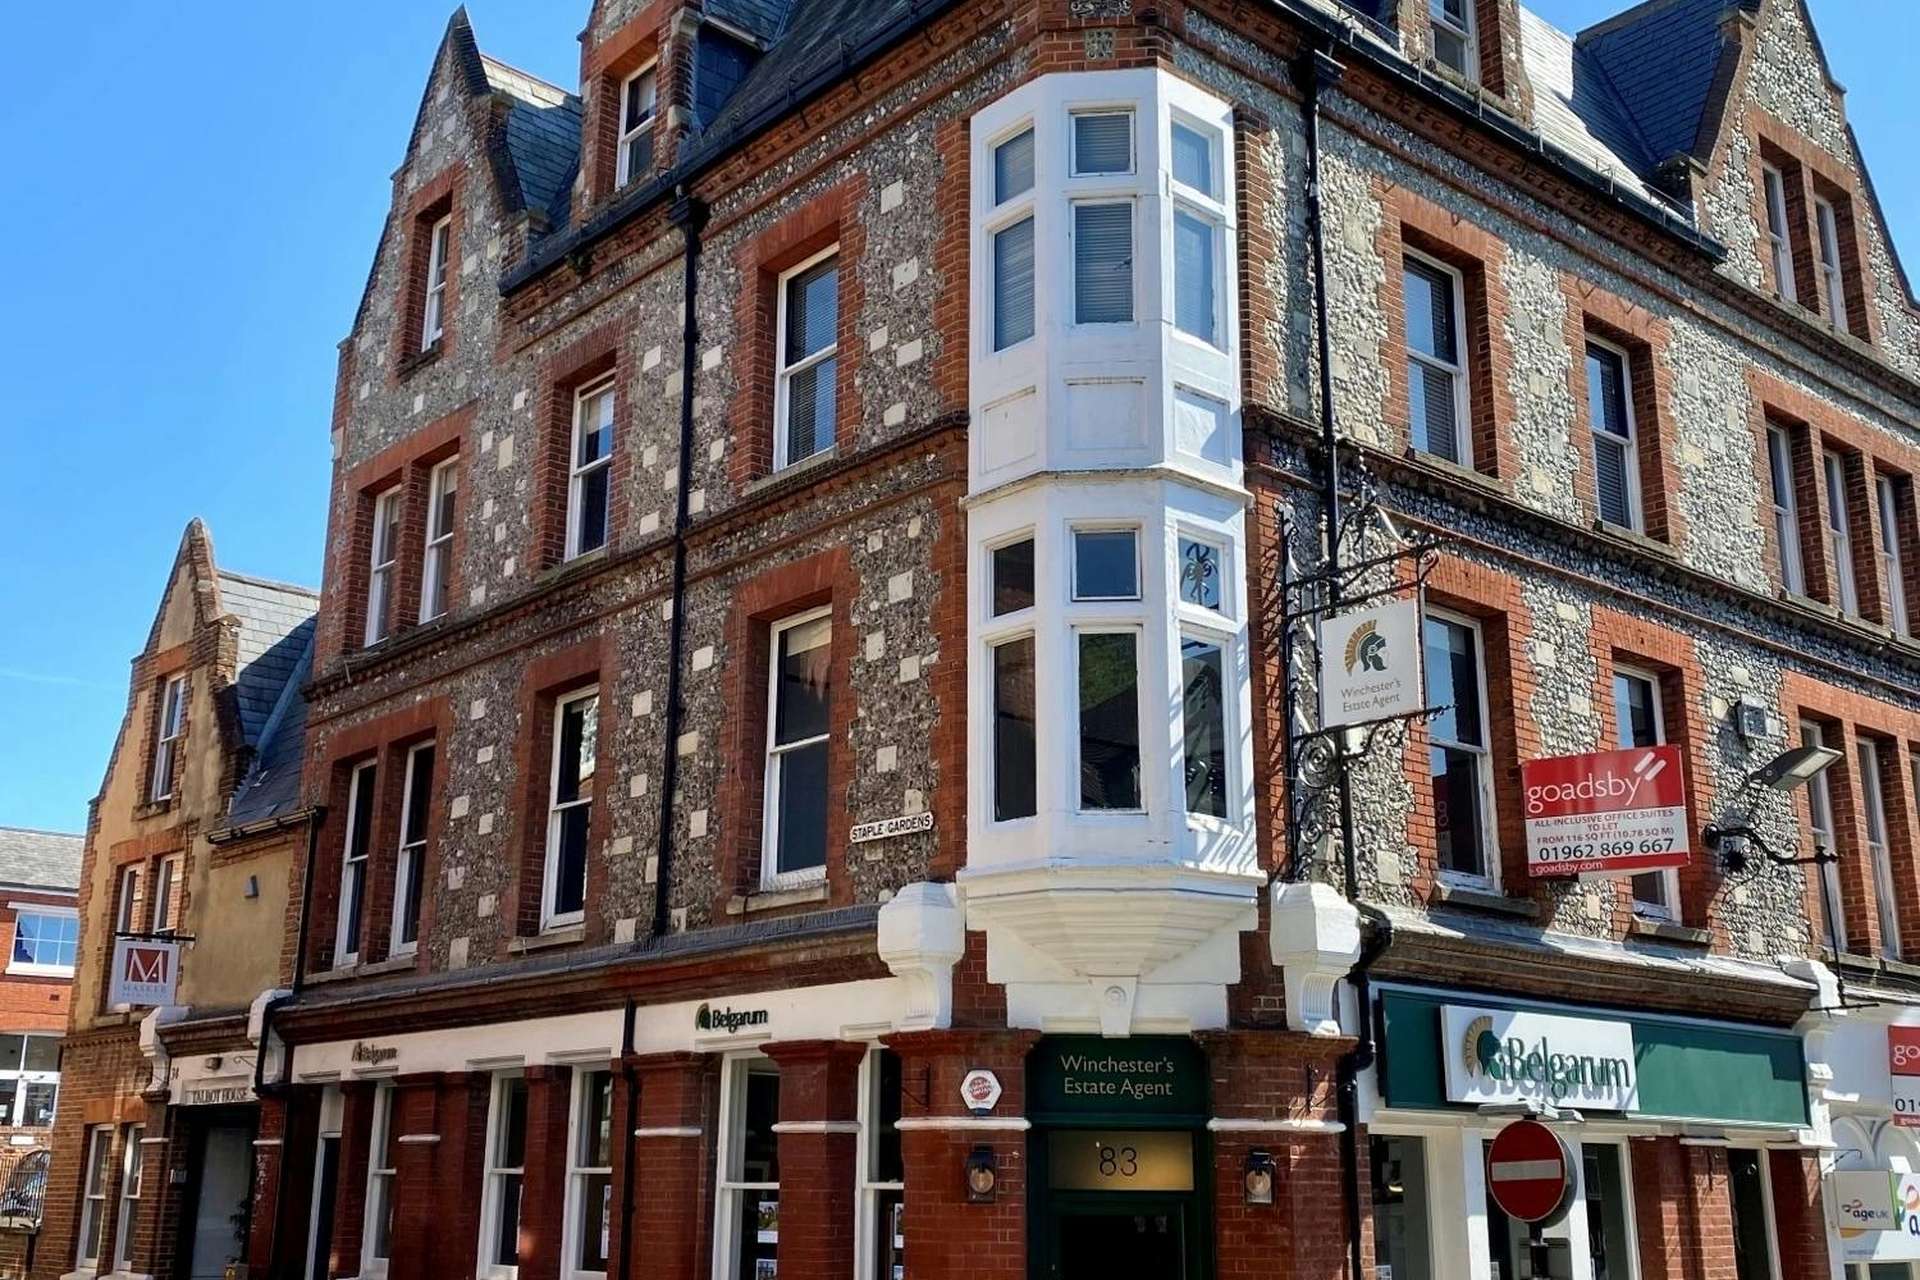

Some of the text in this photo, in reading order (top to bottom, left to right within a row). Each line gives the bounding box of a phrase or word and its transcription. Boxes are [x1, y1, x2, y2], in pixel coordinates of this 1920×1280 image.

[1341, 677, 1402, 698] Winchester's
[1343, 693, 1401, 713] Estate Agent
[1527, 770, 1641, 814] goadsby
[852, 814, 931, 840] STAPLE GARDENS
[1534, 809, 1675, 828] ALL INCLUSIVE OFFICE SUITES
[1587, 822, 1619, 832] TO LET
[1537, 835, 1565, 845] FROM
[1584, 832, 1599, 842] SQ
[1600, 830, 1613, 840] FT
[1644, 828, 1659, 838] SQ
[1539, 838, 1675, 861] 01962 869 667
[1535, 861, 1604, 875] goadsby.com
[712, 1006, 769, 1033] Belgarum
[1061, 1055, 1174, 1073] Winchester's
[1508, 1036, 1630, 1100] Belgarum
[192, 1087, 248, 1104] TALBOT HOUSE
[1064, 1077, 1173, 1099] Estate Agent
[1895, 1098, 1920, 1113] 01
[1099, 1146, 1137, 1176] 83
[1852, 1209, 1875, 1222] age
